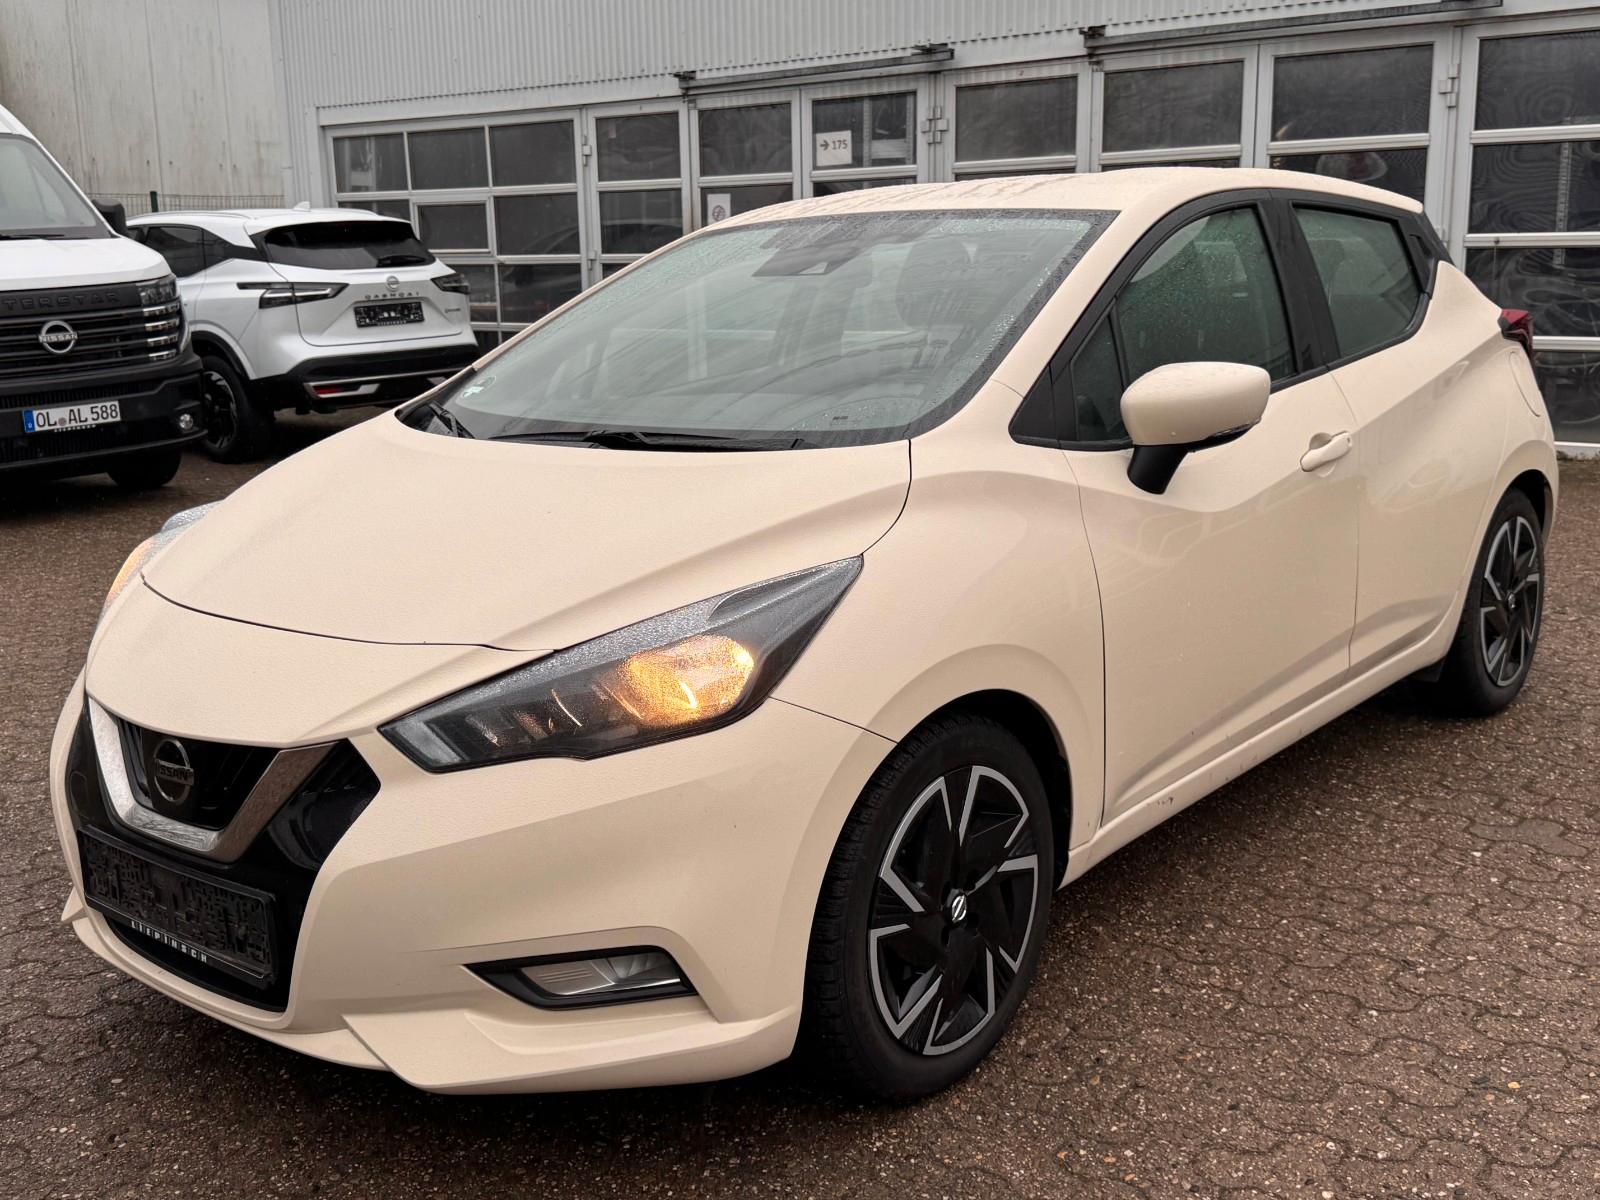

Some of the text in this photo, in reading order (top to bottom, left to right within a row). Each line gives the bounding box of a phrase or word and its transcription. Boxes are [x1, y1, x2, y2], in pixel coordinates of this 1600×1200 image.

[831, 139, 848, 150] 175
[35, 411, 57, 428] OL
[68, 408, 88, 425] AL
[90, 403, 119, 421] 588
[156, 762, 189, 781] SSAN
